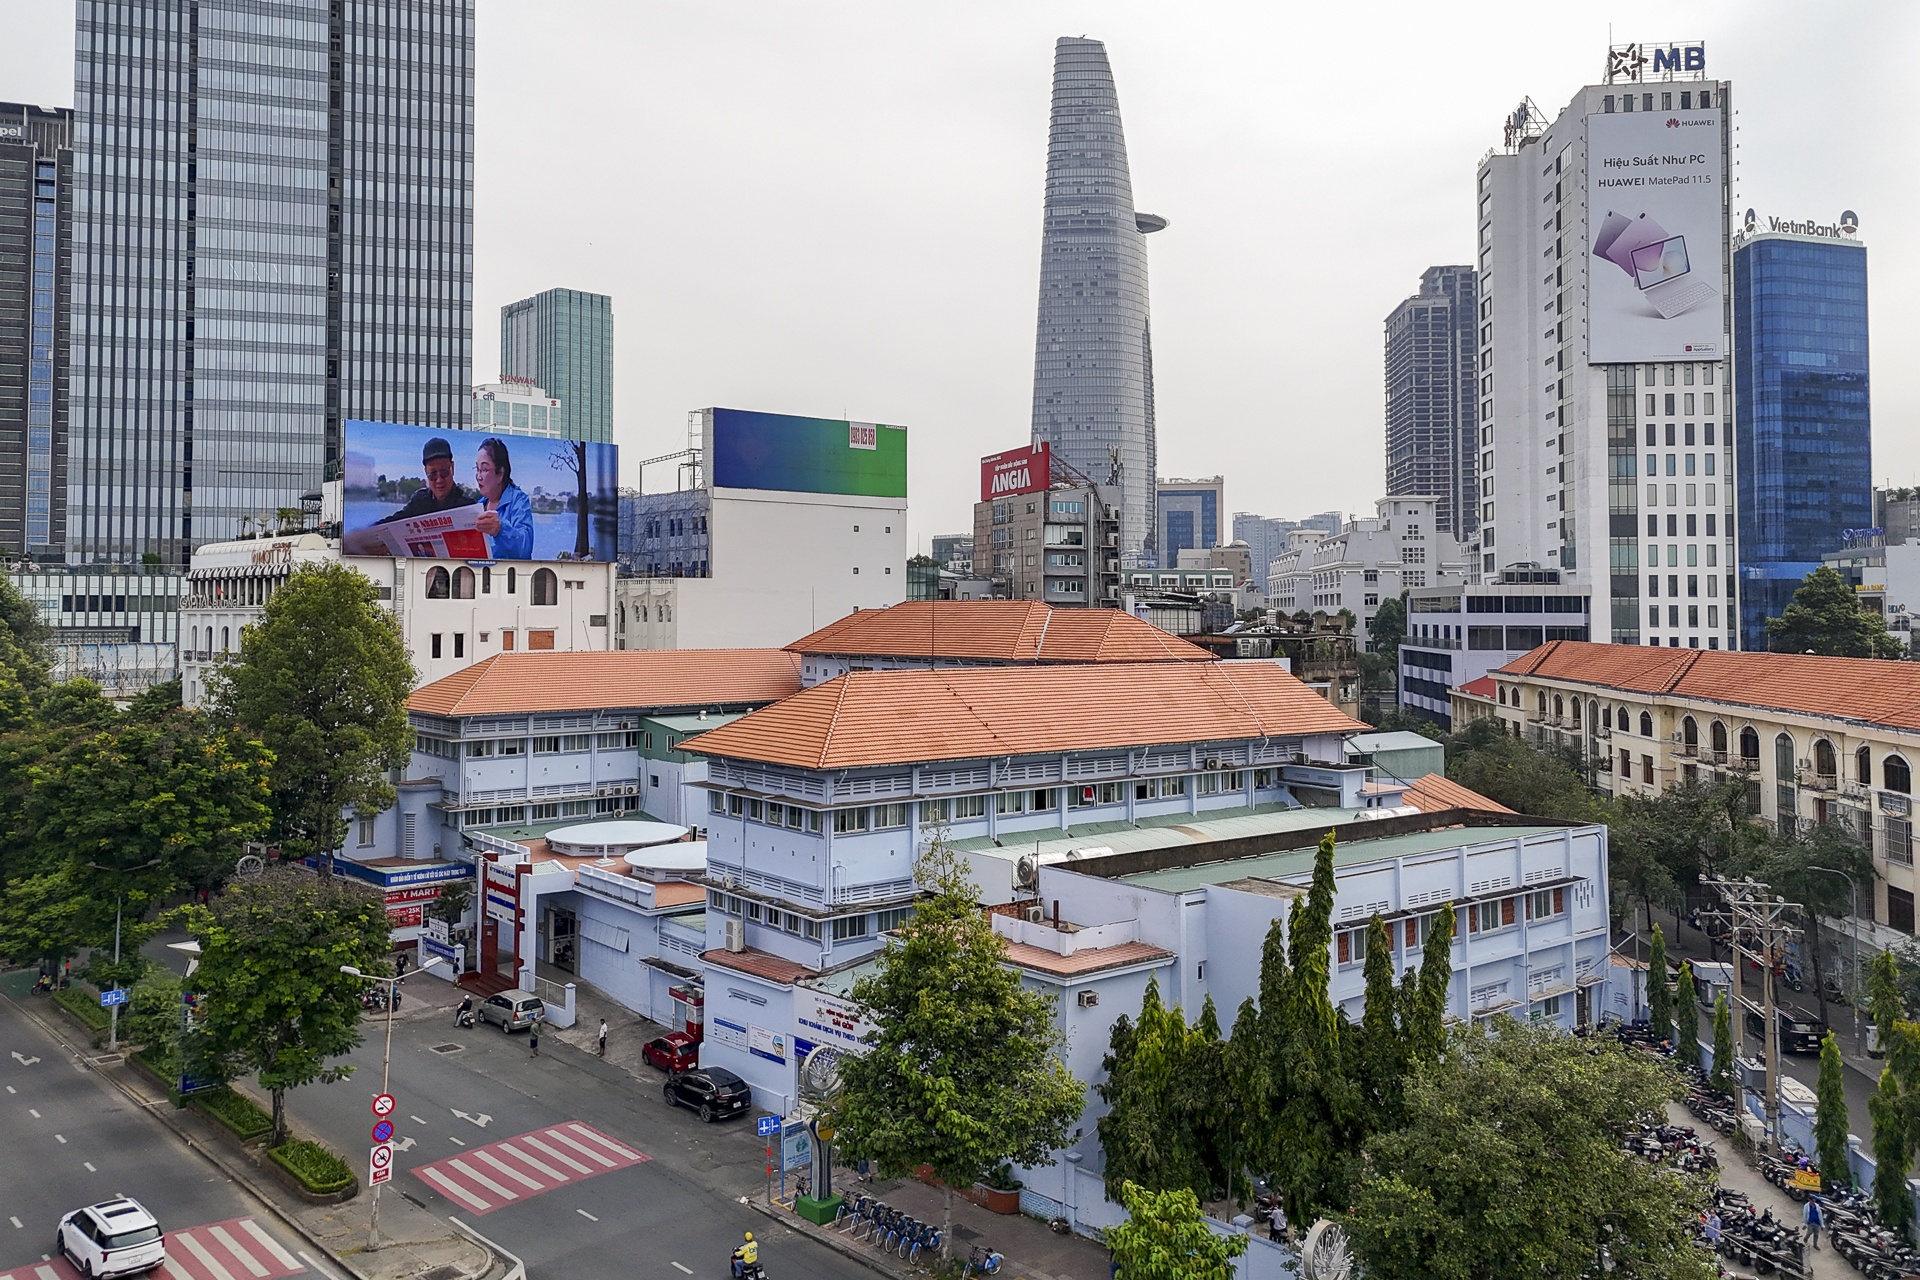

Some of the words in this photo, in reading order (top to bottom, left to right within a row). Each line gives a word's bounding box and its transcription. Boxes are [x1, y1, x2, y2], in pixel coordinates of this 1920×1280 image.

[1653, 46, 1706, 72] MB
[0, 126, 22, 136] pel
[1604, 158, 1629, 169] Hiệu
[1632, 154, 1659, 166] Suất
[1662, 155, 1687, 165] Như
[1690, 154, 1705, 164] PC
[1598, 178, 1645, 187] HUAWEI
[1648, 175, 1690, 185] MatePad
[1692, 175, 1711, 184] 11.5
[1768, 216, 1842, 238] VietinBank
[499, 374, 536, 384] SUNWAH
[483, 392, 495, 400] citi
[410, 888, 436, 898] MART
[842, 1031, 855, 1041] THEO
